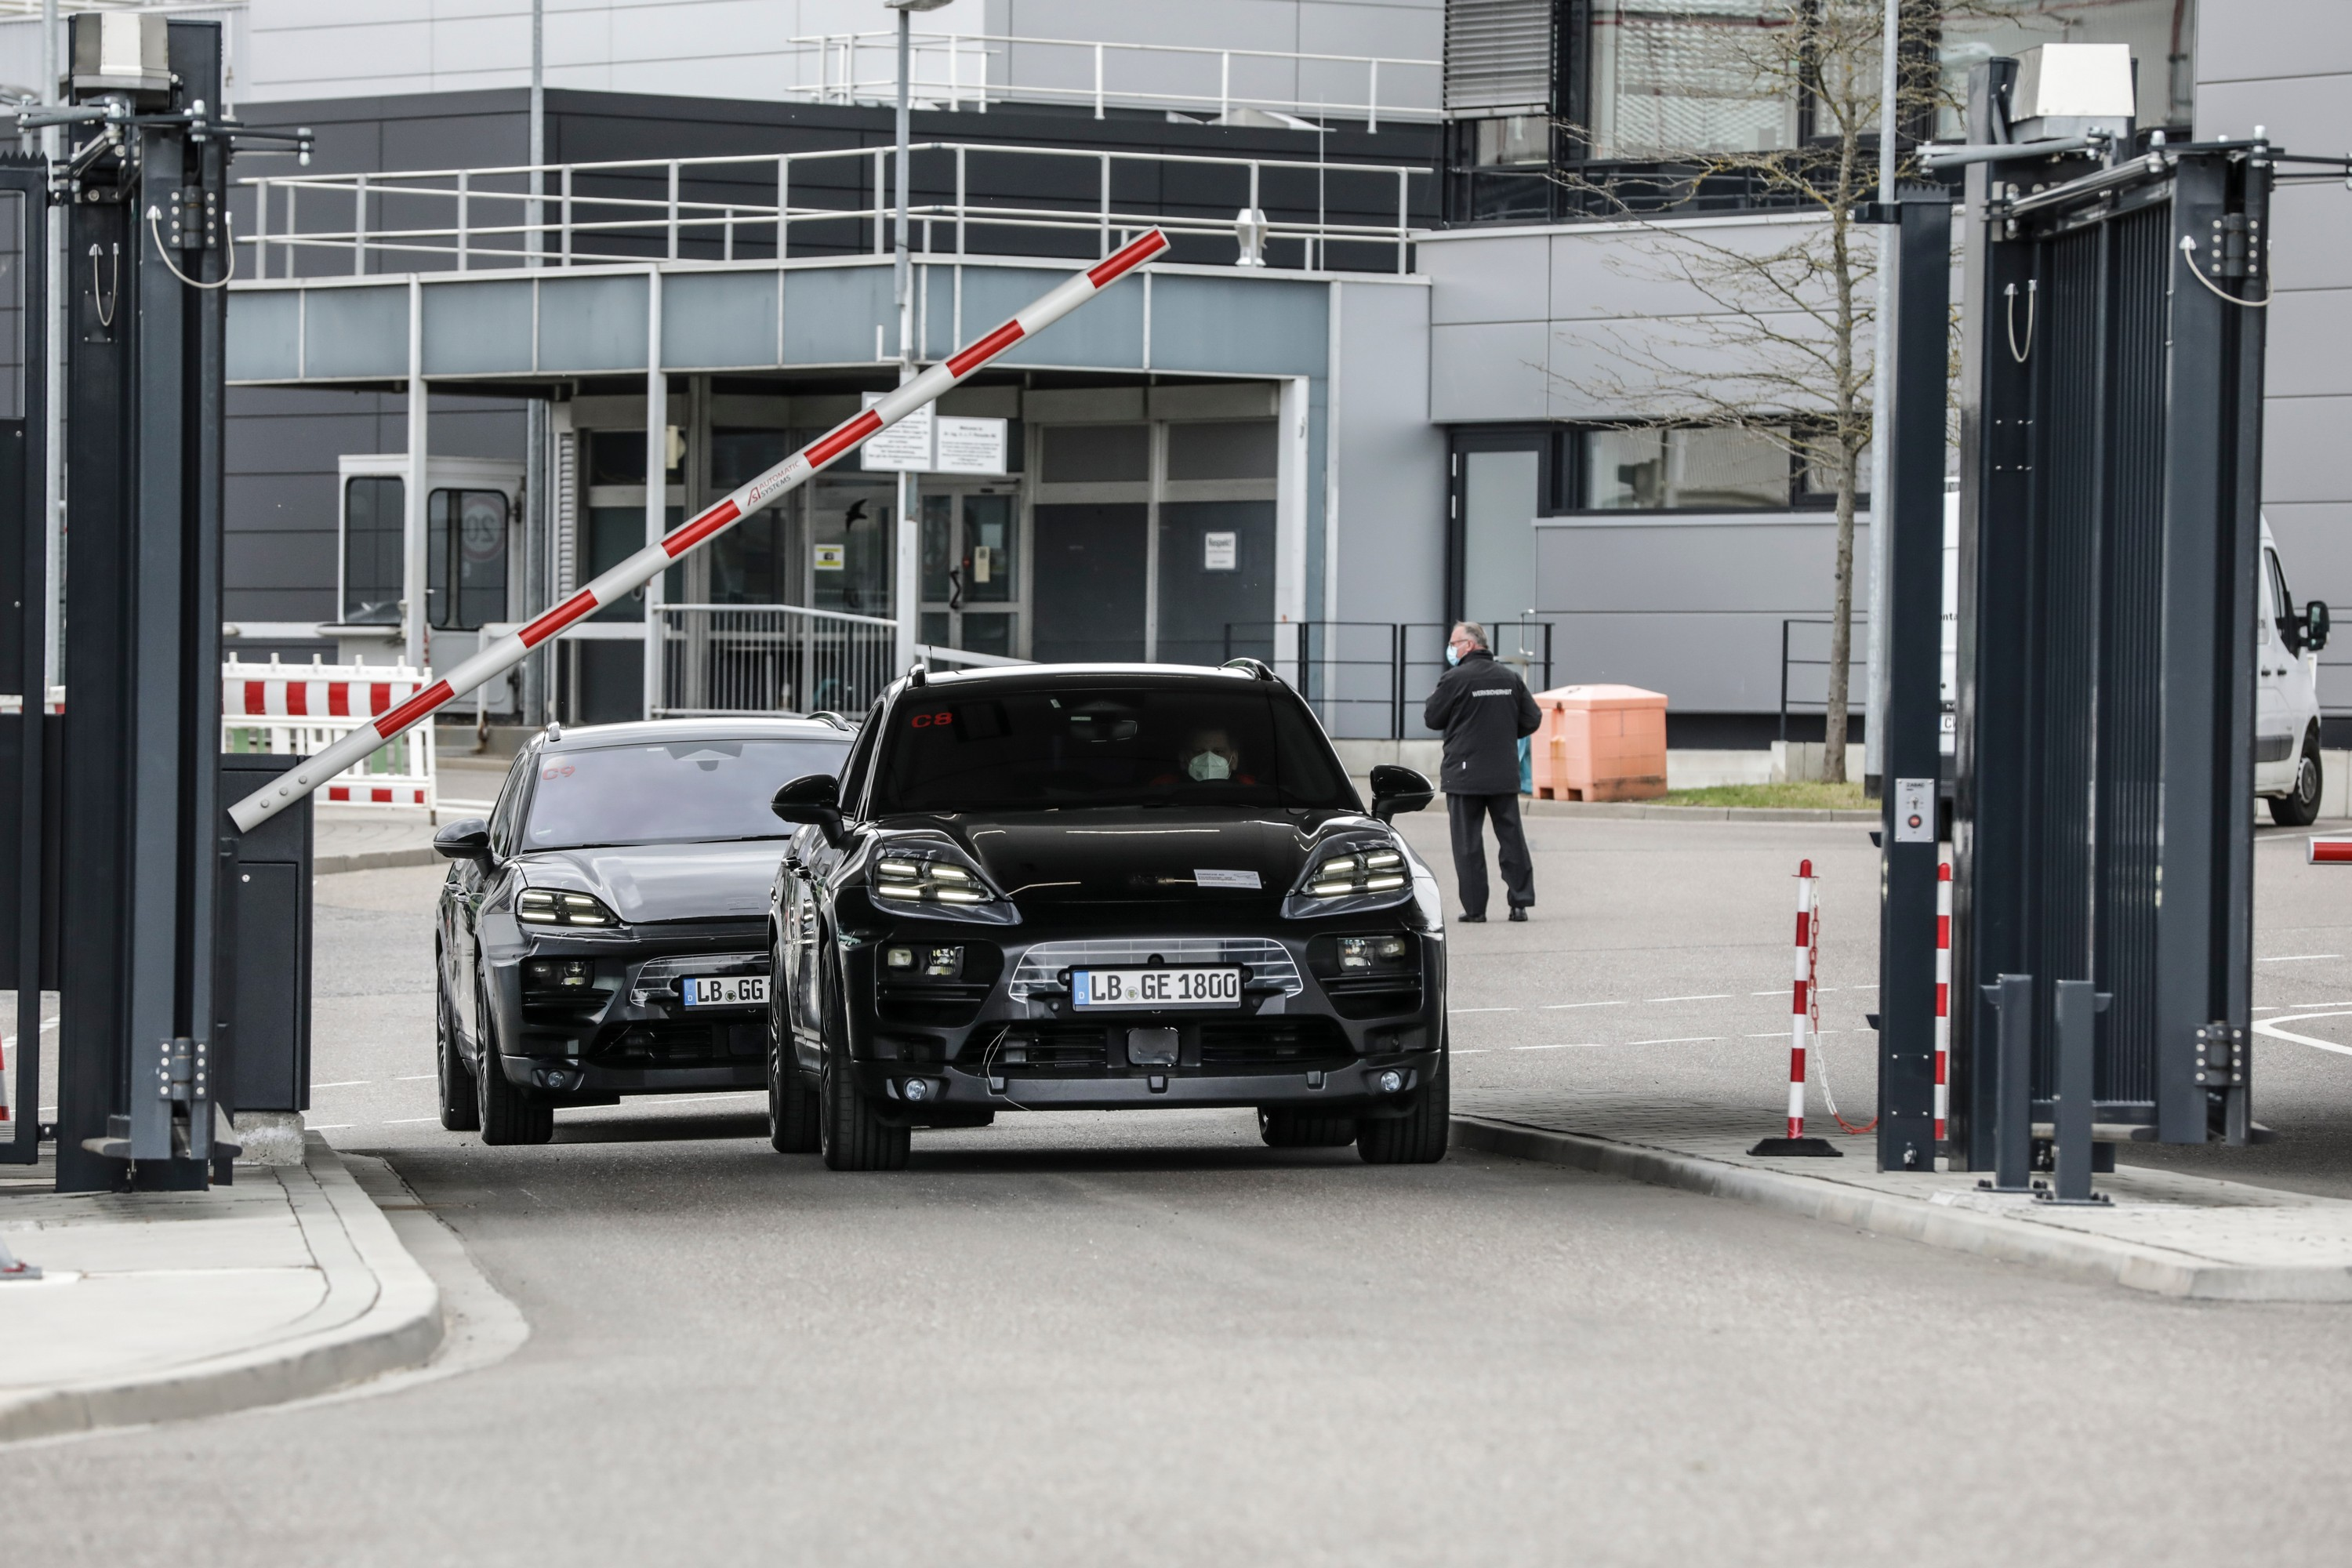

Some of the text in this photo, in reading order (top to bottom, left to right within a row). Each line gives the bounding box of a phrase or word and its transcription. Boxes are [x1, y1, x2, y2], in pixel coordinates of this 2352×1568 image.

[759, 461, 800, 489] AUTOMATIC
[760, 474, 791, 498] SYSTEMS
[911, 712, 953, 728] C8
[542, 765, 576, 781] C9
[697, 978, 764, 1003] LB GG
[1091, 973, 1237, 1000] LB GE 1800
